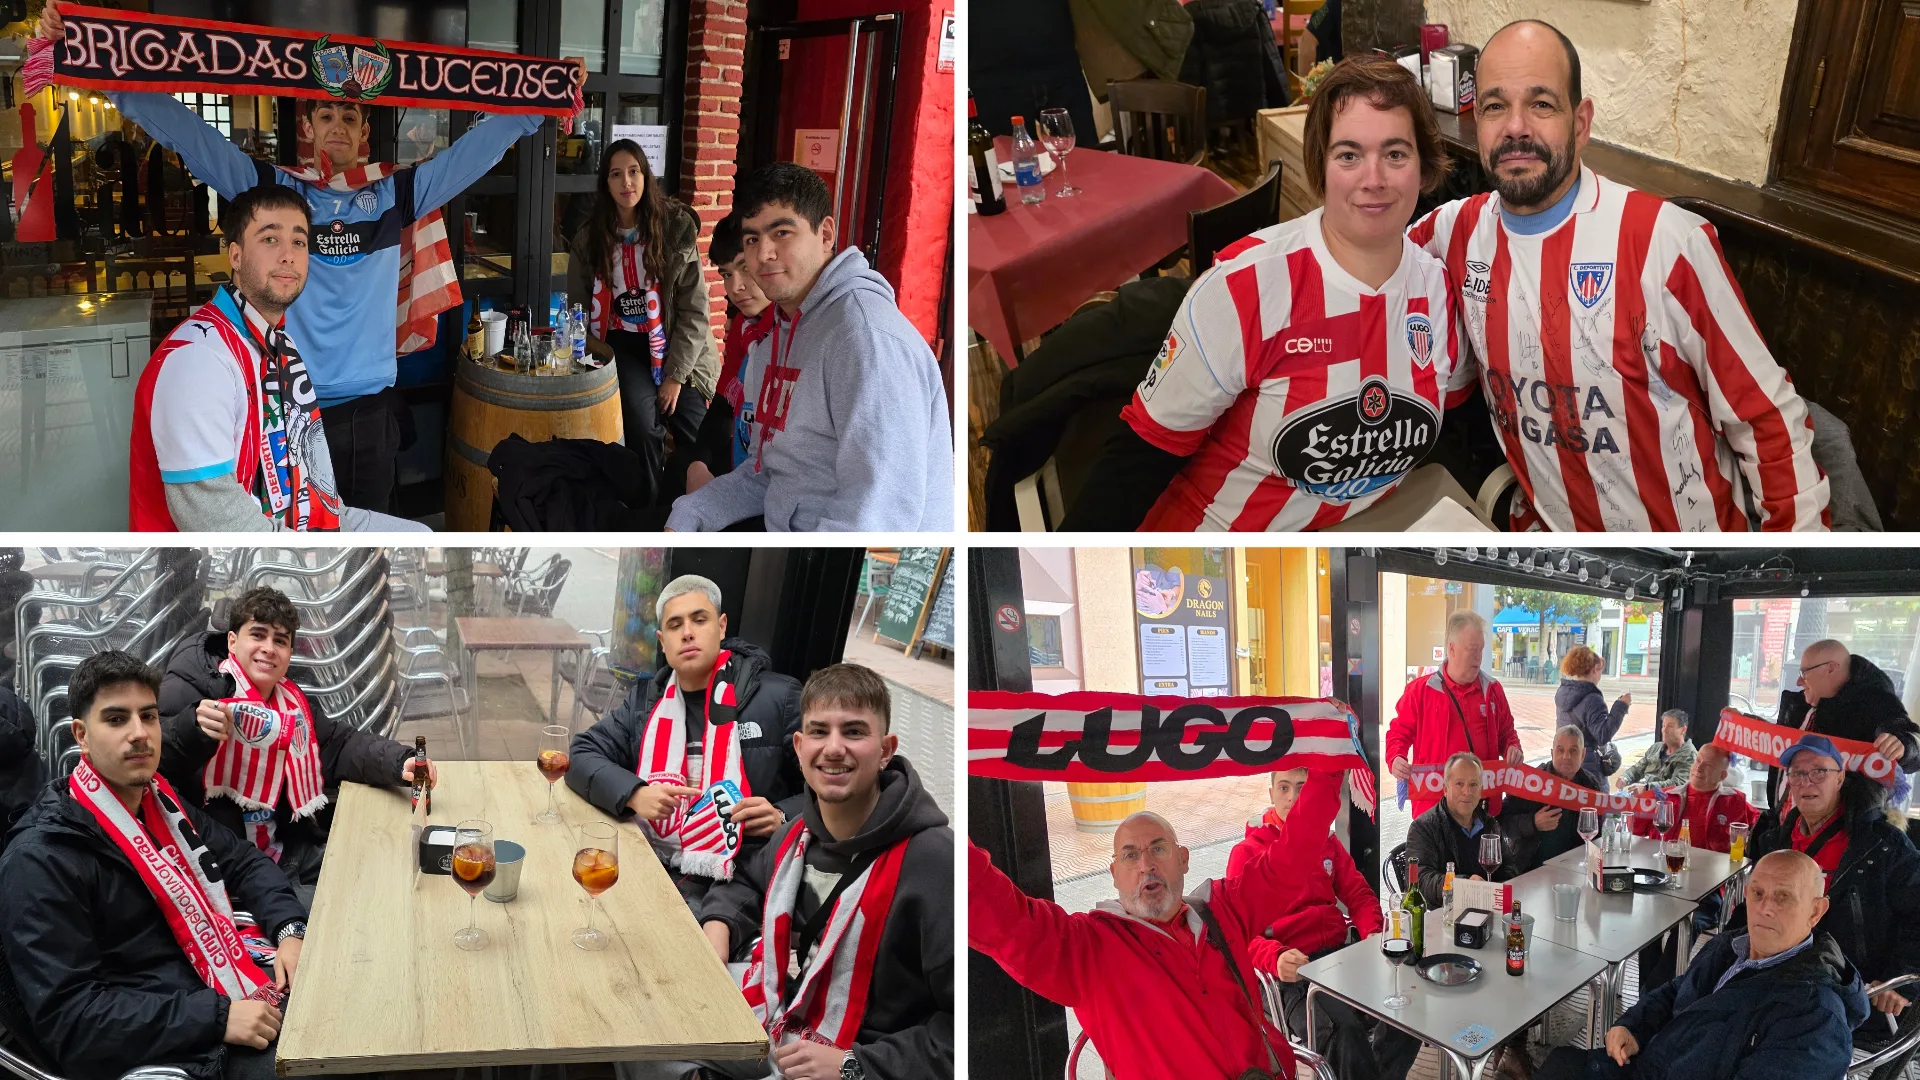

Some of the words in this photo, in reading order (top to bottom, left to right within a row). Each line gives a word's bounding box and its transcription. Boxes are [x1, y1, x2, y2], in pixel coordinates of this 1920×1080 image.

[63, 20, 307, 81] BRIGADAS
[397, 53, 581, 101] LUCENSES
[333, 200, 342, 214] 7
[316, 233, 360, 245] Estrella
[318, 244, 359, 256] Galicia
[620, 296, 646, 307] Estrell
[622, 305, 647, 316] Galici
[1410, 323, 1430, 333] LUGO
[1301, 418, 1428, 460] Estrella
[261, 433, 280, 495] DEPORTIV
[1304, 451, 1414, 486] Galicia
[1186, 599, 1224, 610] DRAGON
[1195, 610, 1217, 618] NAILS
[238, 704, 270, 720] LUGO
[1004, 703, 1294, 773] LUGO
[1559, 783, 1588, 804] DE
